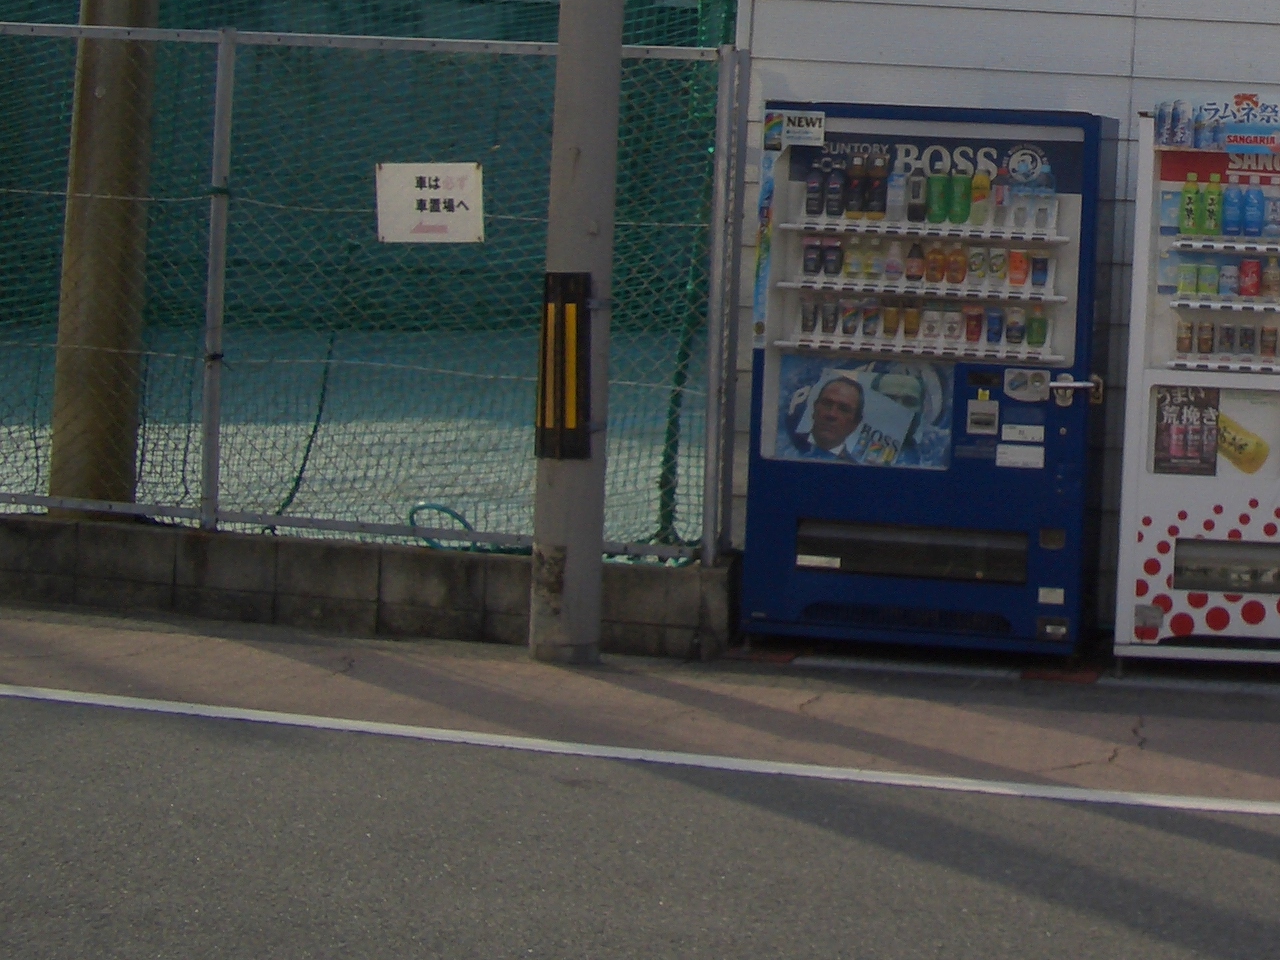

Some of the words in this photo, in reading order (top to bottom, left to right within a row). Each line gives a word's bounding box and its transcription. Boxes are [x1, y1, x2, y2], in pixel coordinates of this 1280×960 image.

[786, 116, 823, 129] NEW!
[1226, 134, 1276, 145] SANGARIA
[821, 141, 889, 155] SUNTORY
[894, 143, 998, 181] BOSS
